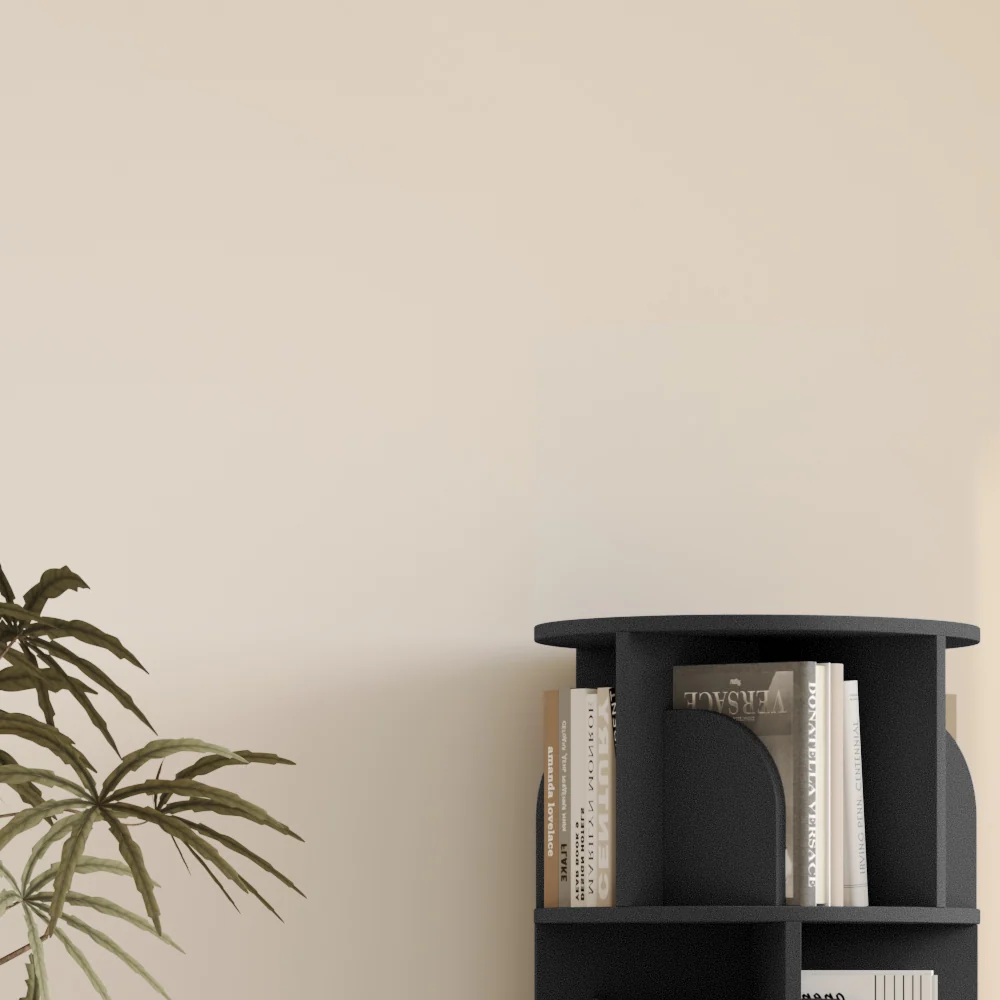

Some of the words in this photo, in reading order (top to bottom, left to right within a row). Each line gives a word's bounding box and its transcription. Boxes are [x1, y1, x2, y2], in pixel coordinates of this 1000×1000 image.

[684, 689, 787, 715] VERSACE
[808, 682, 816, 796] DONATELLA
[852, 721, 862, 791] CENTENNIAL
[547, 746, 555, 798] amanda
[547, 802, 555, 857] lovelace
[808, 801, 816, 888] VERSACE
[857, 832, 866, 875] IRVING
